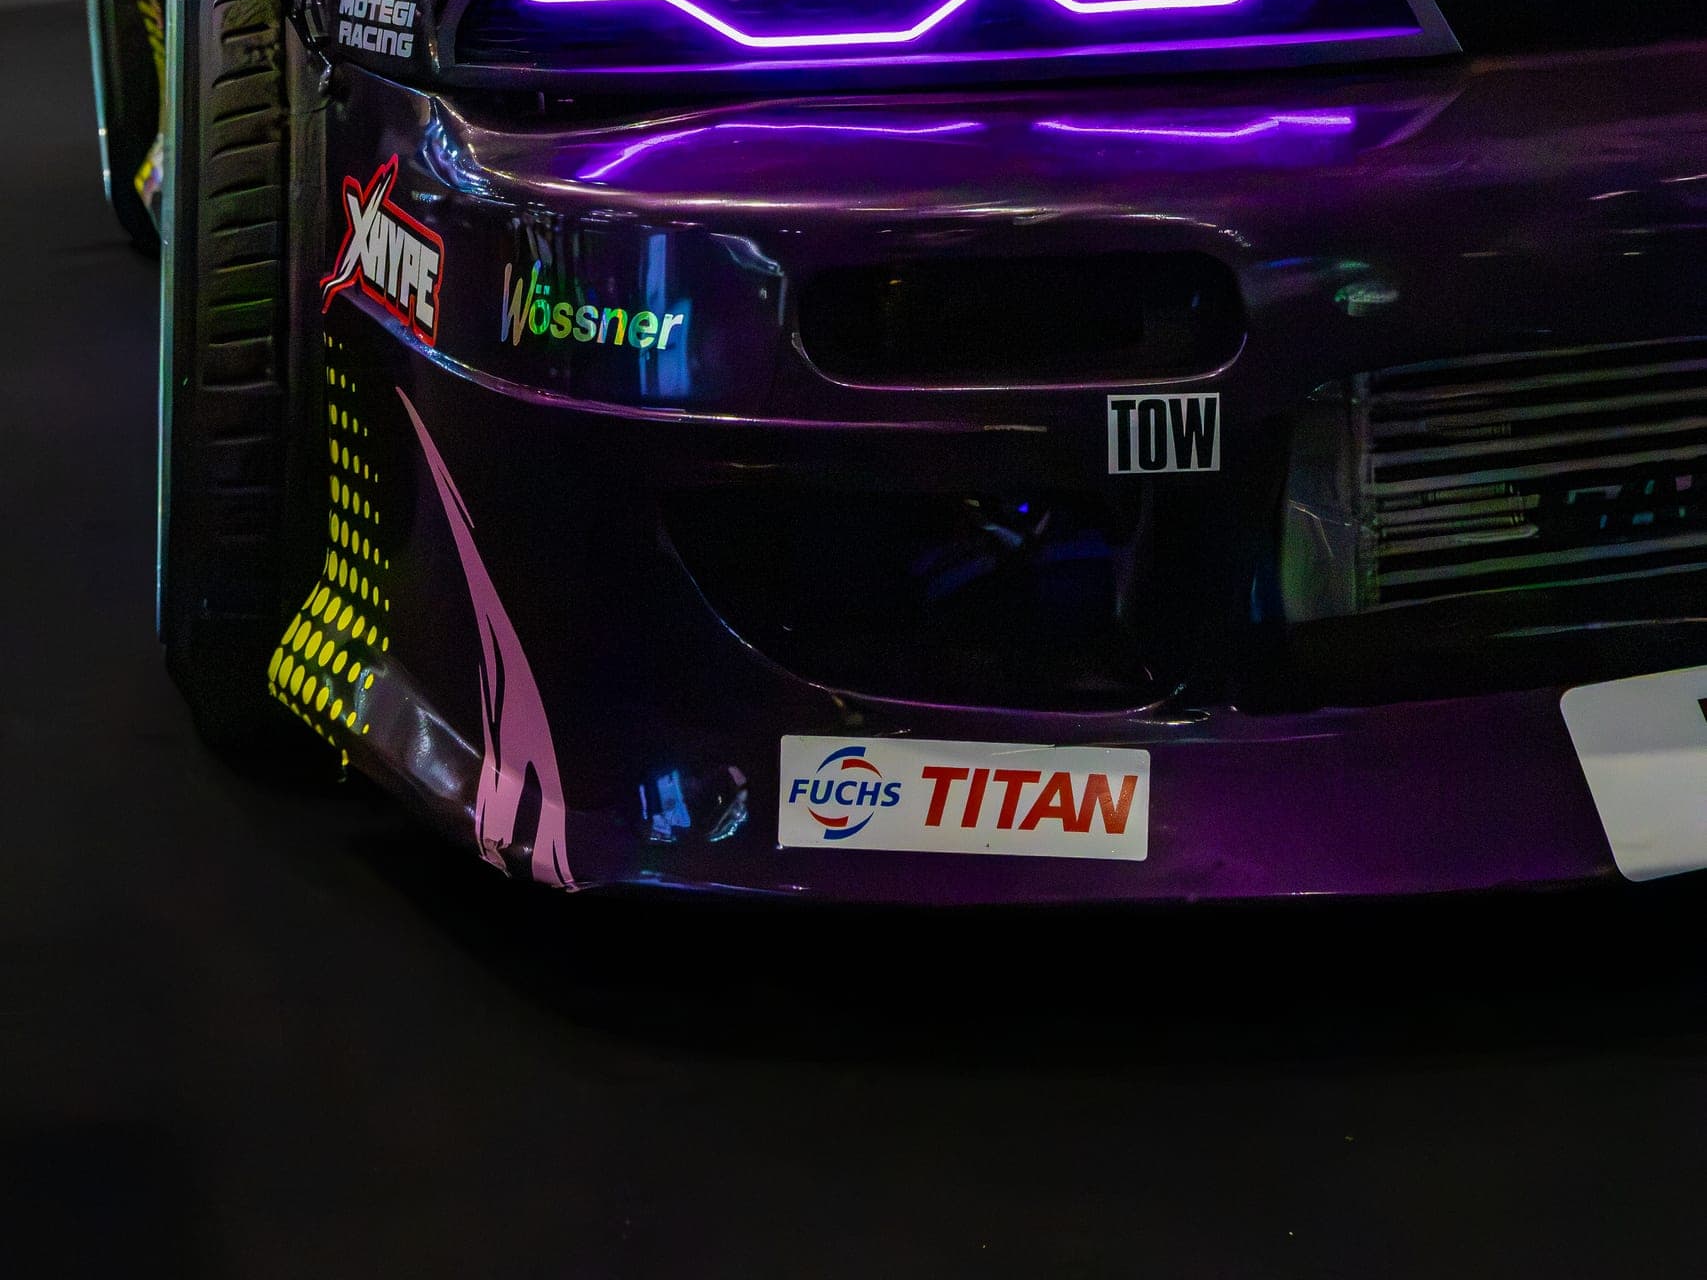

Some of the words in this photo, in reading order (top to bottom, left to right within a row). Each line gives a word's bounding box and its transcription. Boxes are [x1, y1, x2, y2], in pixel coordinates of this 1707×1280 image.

[338, 20, 414, 58] RACING
[501, 258, 685, 351] Wössner
[1110, 397, 1219, 472] TOW
[788, 778, 902, 808] FUCHS
[921, 766, 1139, 835] TITAN
